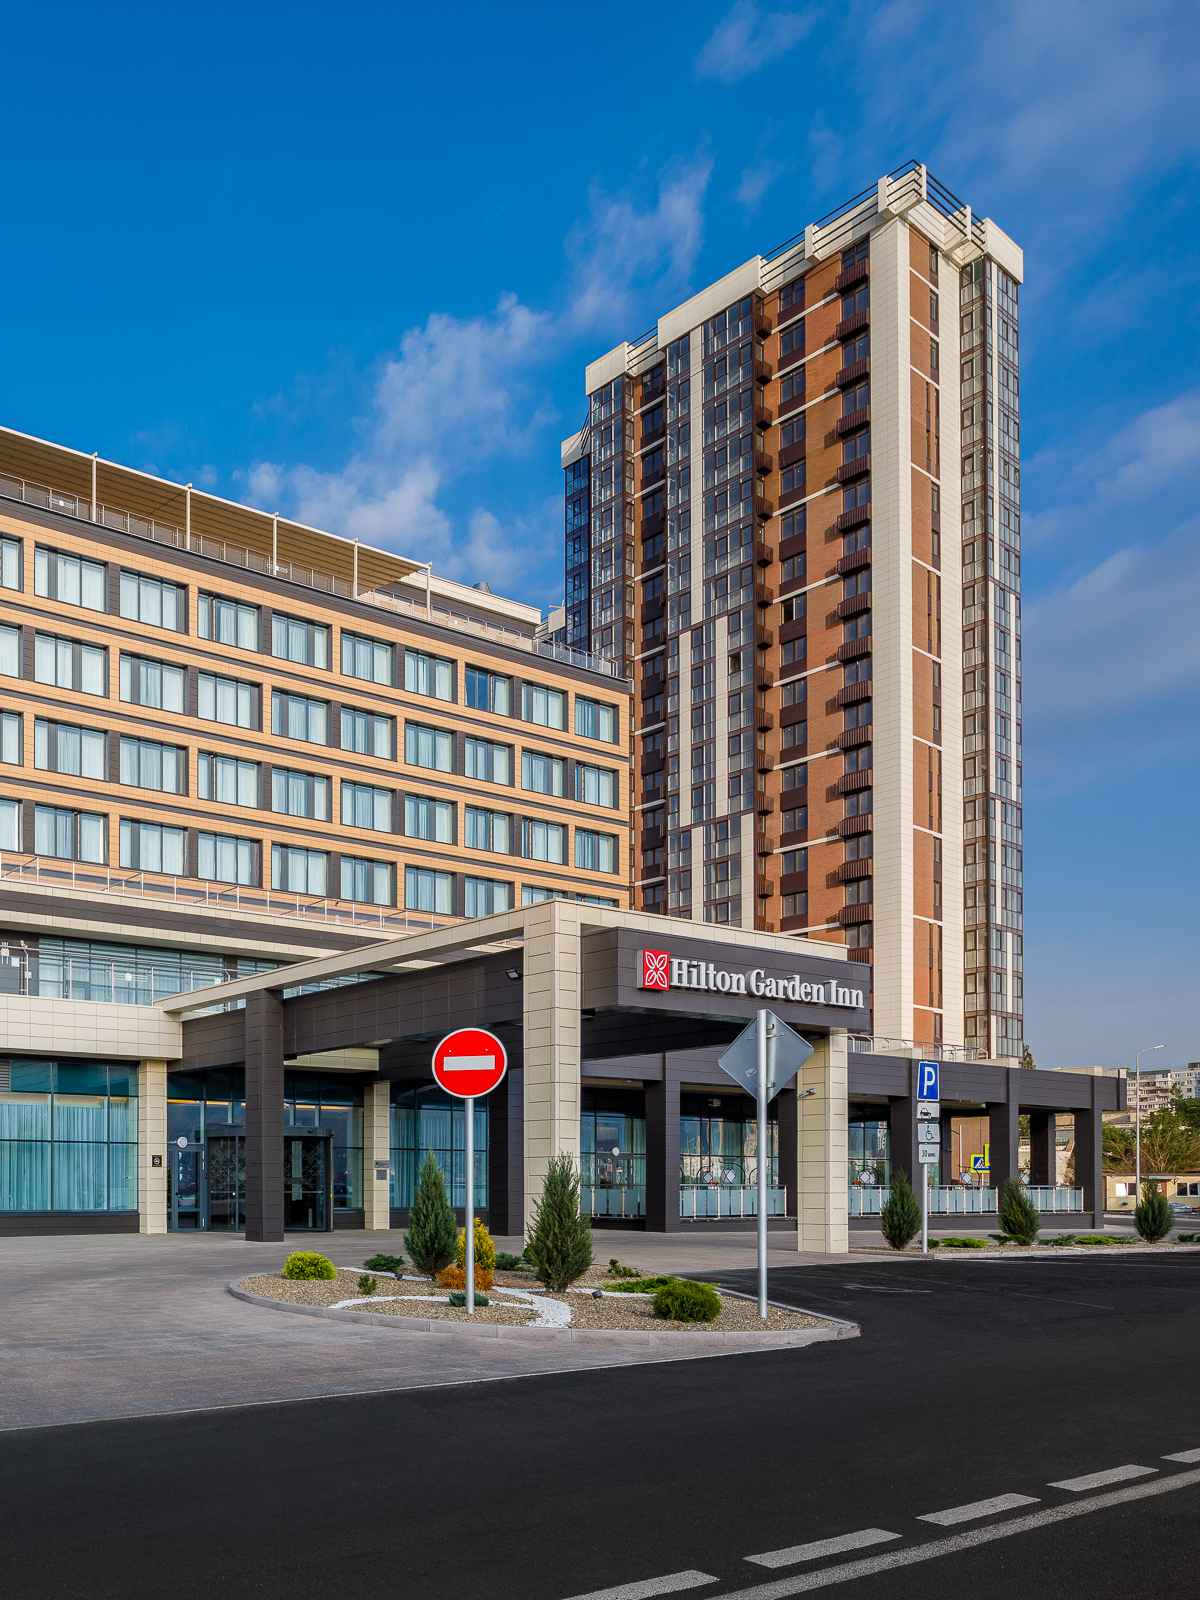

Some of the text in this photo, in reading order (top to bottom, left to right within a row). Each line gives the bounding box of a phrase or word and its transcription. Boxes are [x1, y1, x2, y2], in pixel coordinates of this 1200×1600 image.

[670, 959, 864, 1008] Hilton Garden Inn
[923, 1066, 936, 1096] P
